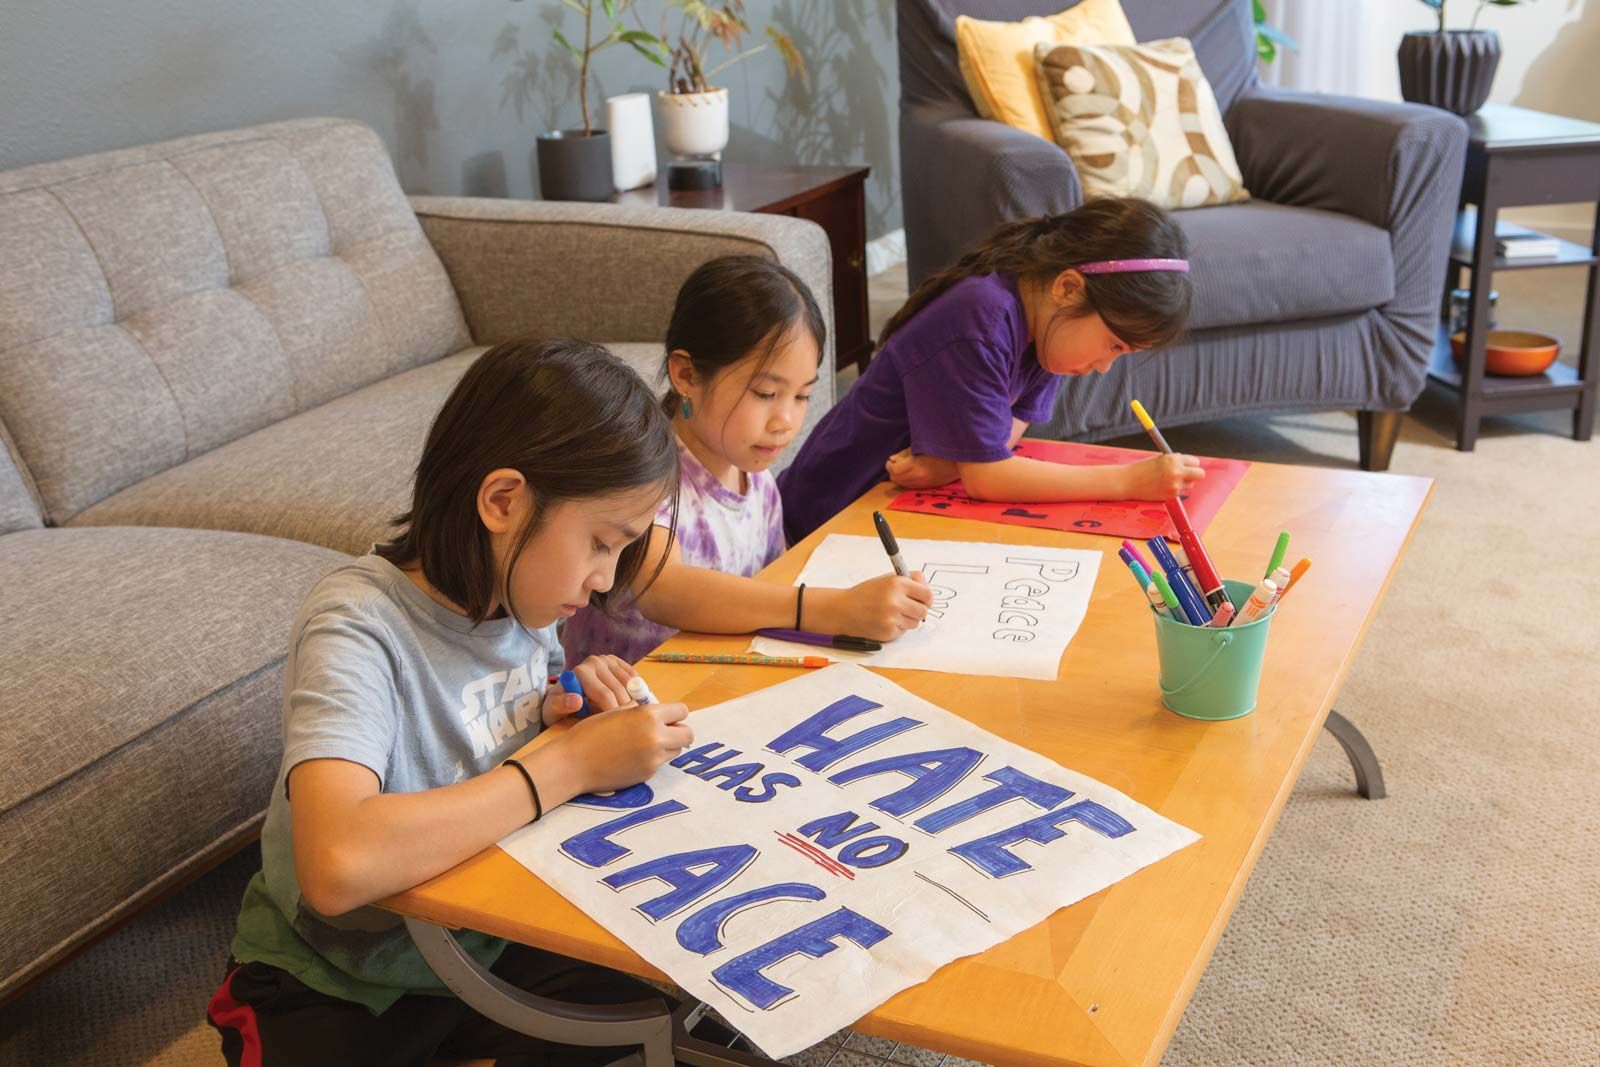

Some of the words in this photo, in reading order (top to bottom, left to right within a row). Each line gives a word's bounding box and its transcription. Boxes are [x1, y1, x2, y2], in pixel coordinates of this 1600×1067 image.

[993, 557, 1080, 643] Peace
[459, 646, 549, 726] STAR
[465, 689, 541, 759] WAR
[669, 742, 801, 803] HAS
[762, 694, 1137, 879] HATE
[799, 811, 909, 869] NO
